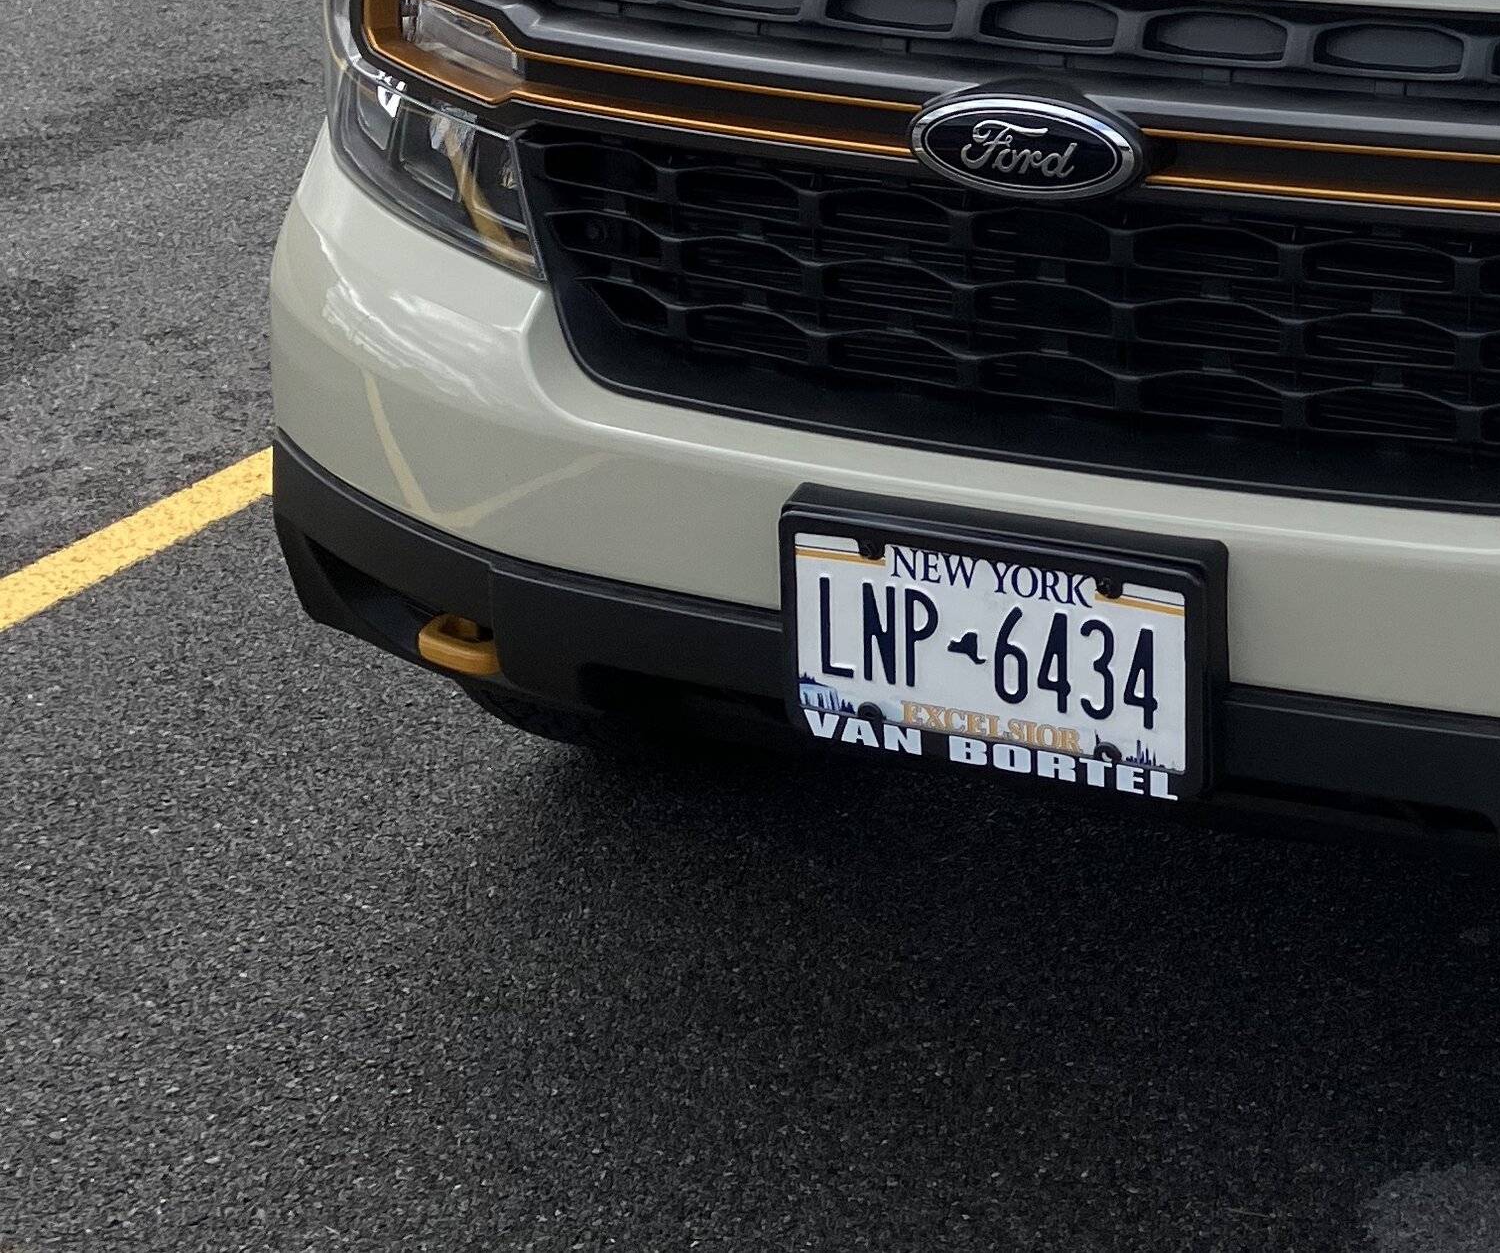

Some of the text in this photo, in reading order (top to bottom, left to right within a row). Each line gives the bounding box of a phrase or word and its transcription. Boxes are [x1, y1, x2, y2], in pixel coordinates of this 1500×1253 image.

[961, 120, 1078, 178] Ford
[891, 546, 1094, 609] NEW YORK
[819, 576, 1159, 730] LNP 6434
[803, 707, 1179, 801] VAN BORTEL
[900, 700, 1083, 754] EXCELSIOR
